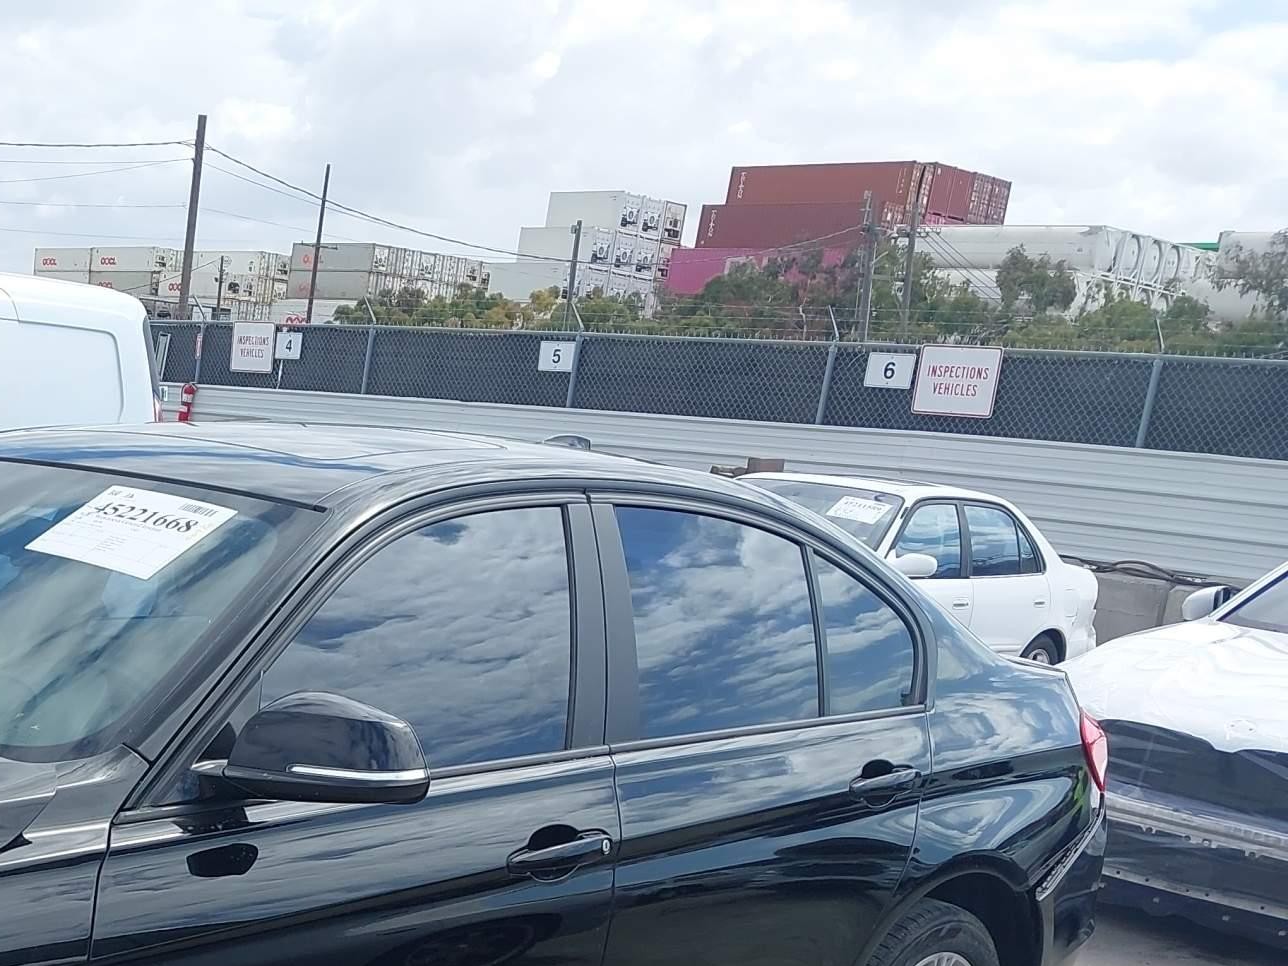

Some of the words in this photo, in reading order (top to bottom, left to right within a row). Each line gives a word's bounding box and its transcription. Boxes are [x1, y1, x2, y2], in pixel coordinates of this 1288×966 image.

[237, 336, 269, 346] INSPECTIONS
[285, 339, 292, 352] 4
[240, 348, 264, 358] VEHICLES
[552, 349, 561, 363] 5
[883, 362, 896, 379] 6
[927, 365, 989, 380] INSPECTIONS
[933, 382, 978, 397] VEHICLES
[94, 501, 200, 534] 45221668
